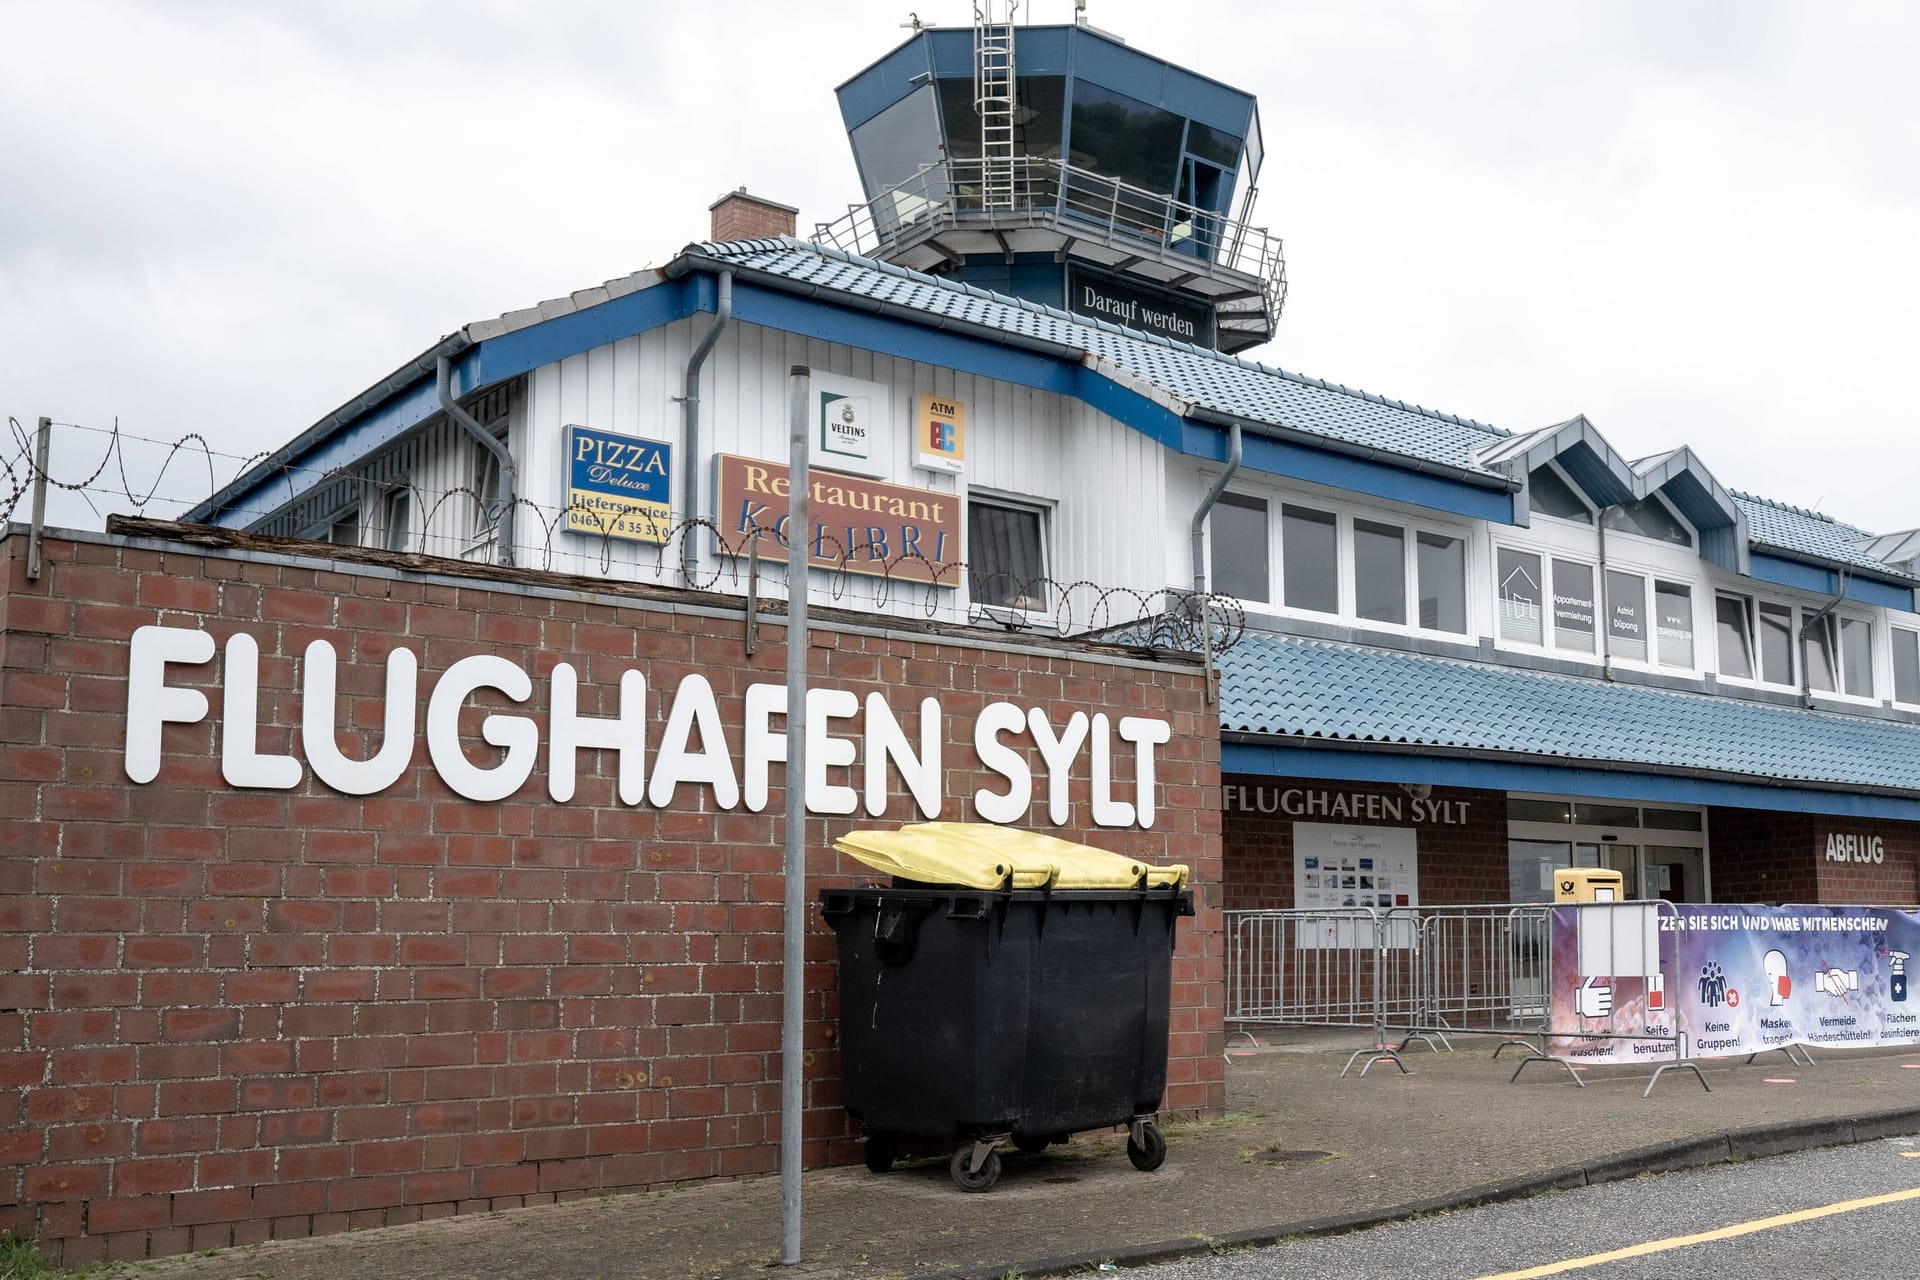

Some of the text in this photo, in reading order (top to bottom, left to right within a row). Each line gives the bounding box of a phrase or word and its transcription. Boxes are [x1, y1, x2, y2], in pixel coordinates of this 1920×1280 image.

[1084, 286, 1194, 337] Darauf werden
[930, 401, 955, 416] ATM
[831, 422, 865, 438] VELTINS
[575, 436, 667, 476] PIZZA
[587, 464, 650, 491] Deluxe
[744, 465, 944, 523] Retaurant
[618, 520, 625, 531] 8
[628, 521, 642, 533] 35
[662, 527, 669, 537] 0
[1555, 610, 1592, 624] vermietung
[1616, 605, 1634, 617] Astrid
[124, 625, 1171, 829] FLUGHAFEN SYLT
[1222, 785, 1471, 825] FLUGHAFEN SYLT
[1825, 832, 1884, 865] ABFLUG
[1689, 915, 1708, 931] SIE
[1711, 915, 1738, 931] SICH
[1742, 915, 1769, 931] UND
[1772, 916, 1800, 932] IHRE
[1803, 916, 1889, 932] MITMENSCHEN
[1819, 1015, 1857, 1027] Vermeide
[1886, 1013, 1917, 1024] Flächen
[1645, 1024, 1669, 1036] Seife
[1705, 1022, 1730, 1033] Keine
[1696, 1036, 1741, 1051] Gruppen!
